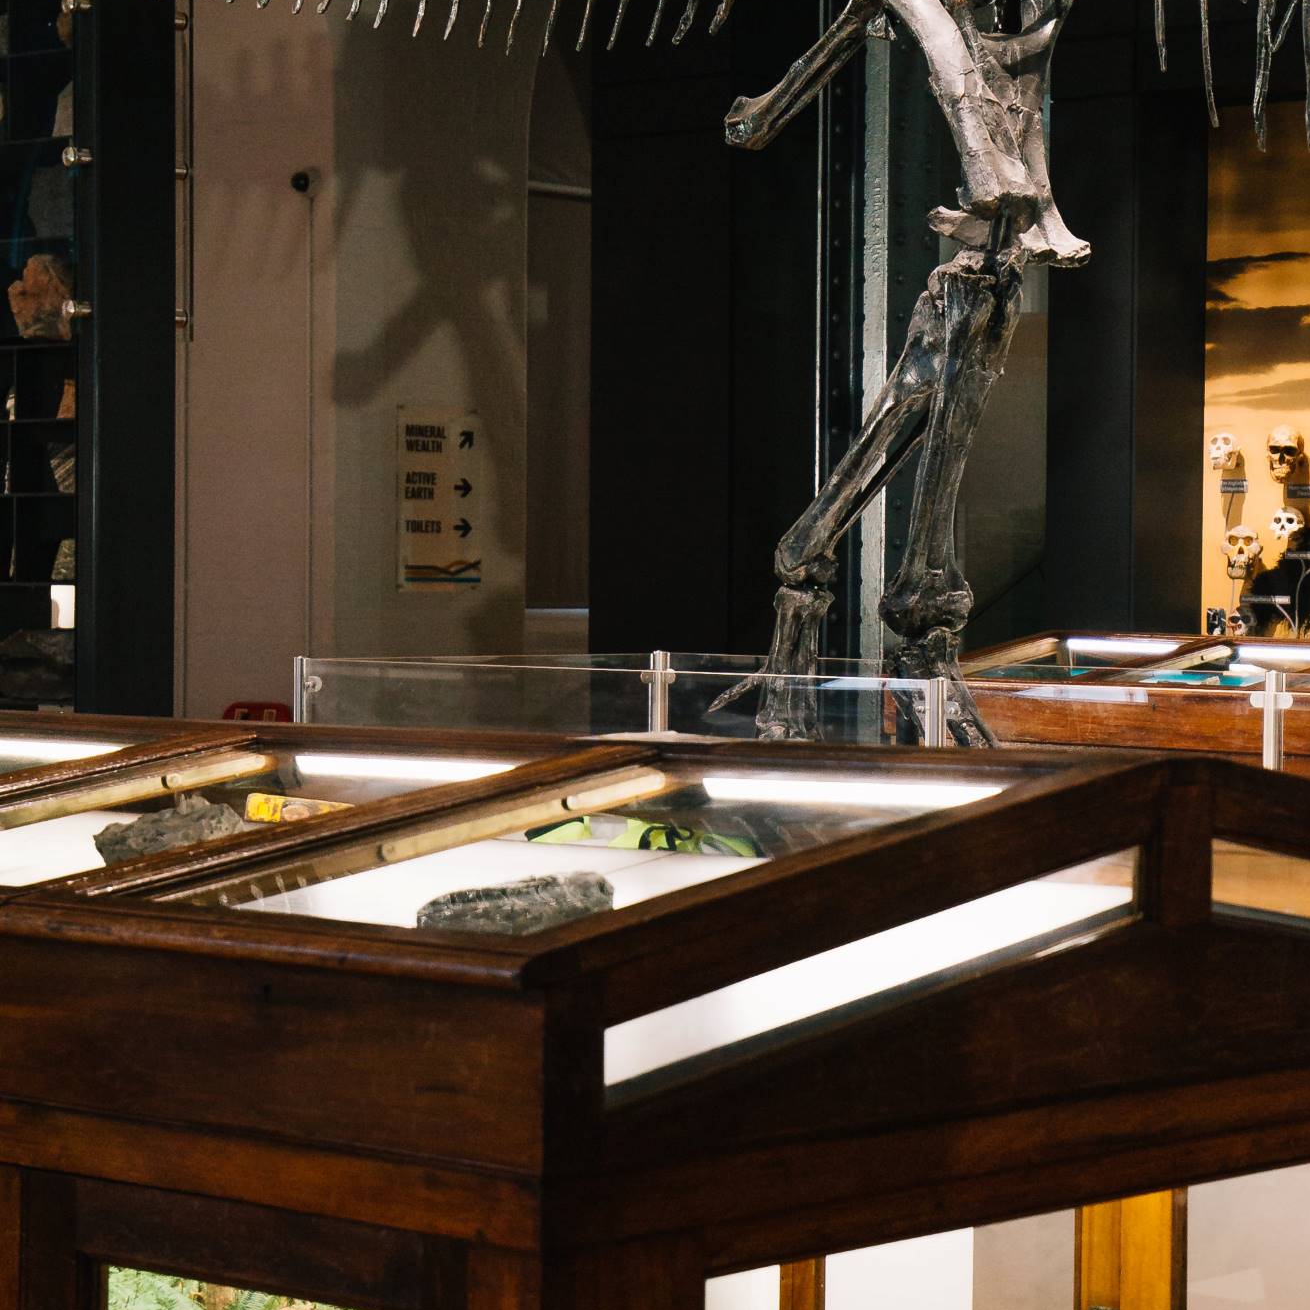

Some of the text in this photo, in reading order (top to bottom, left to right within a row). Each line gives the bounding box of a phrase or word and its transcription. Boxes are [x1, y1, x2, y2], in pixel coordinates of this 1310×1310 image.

[405, 424, 446, 439] MINERAL
[405, 439, 443, 453] WEALTH
[405, 471, 437, 485] ACTIVE
[405, 486, 434, 500] EARTH
[405, 520, 442, 534] TOILETS
